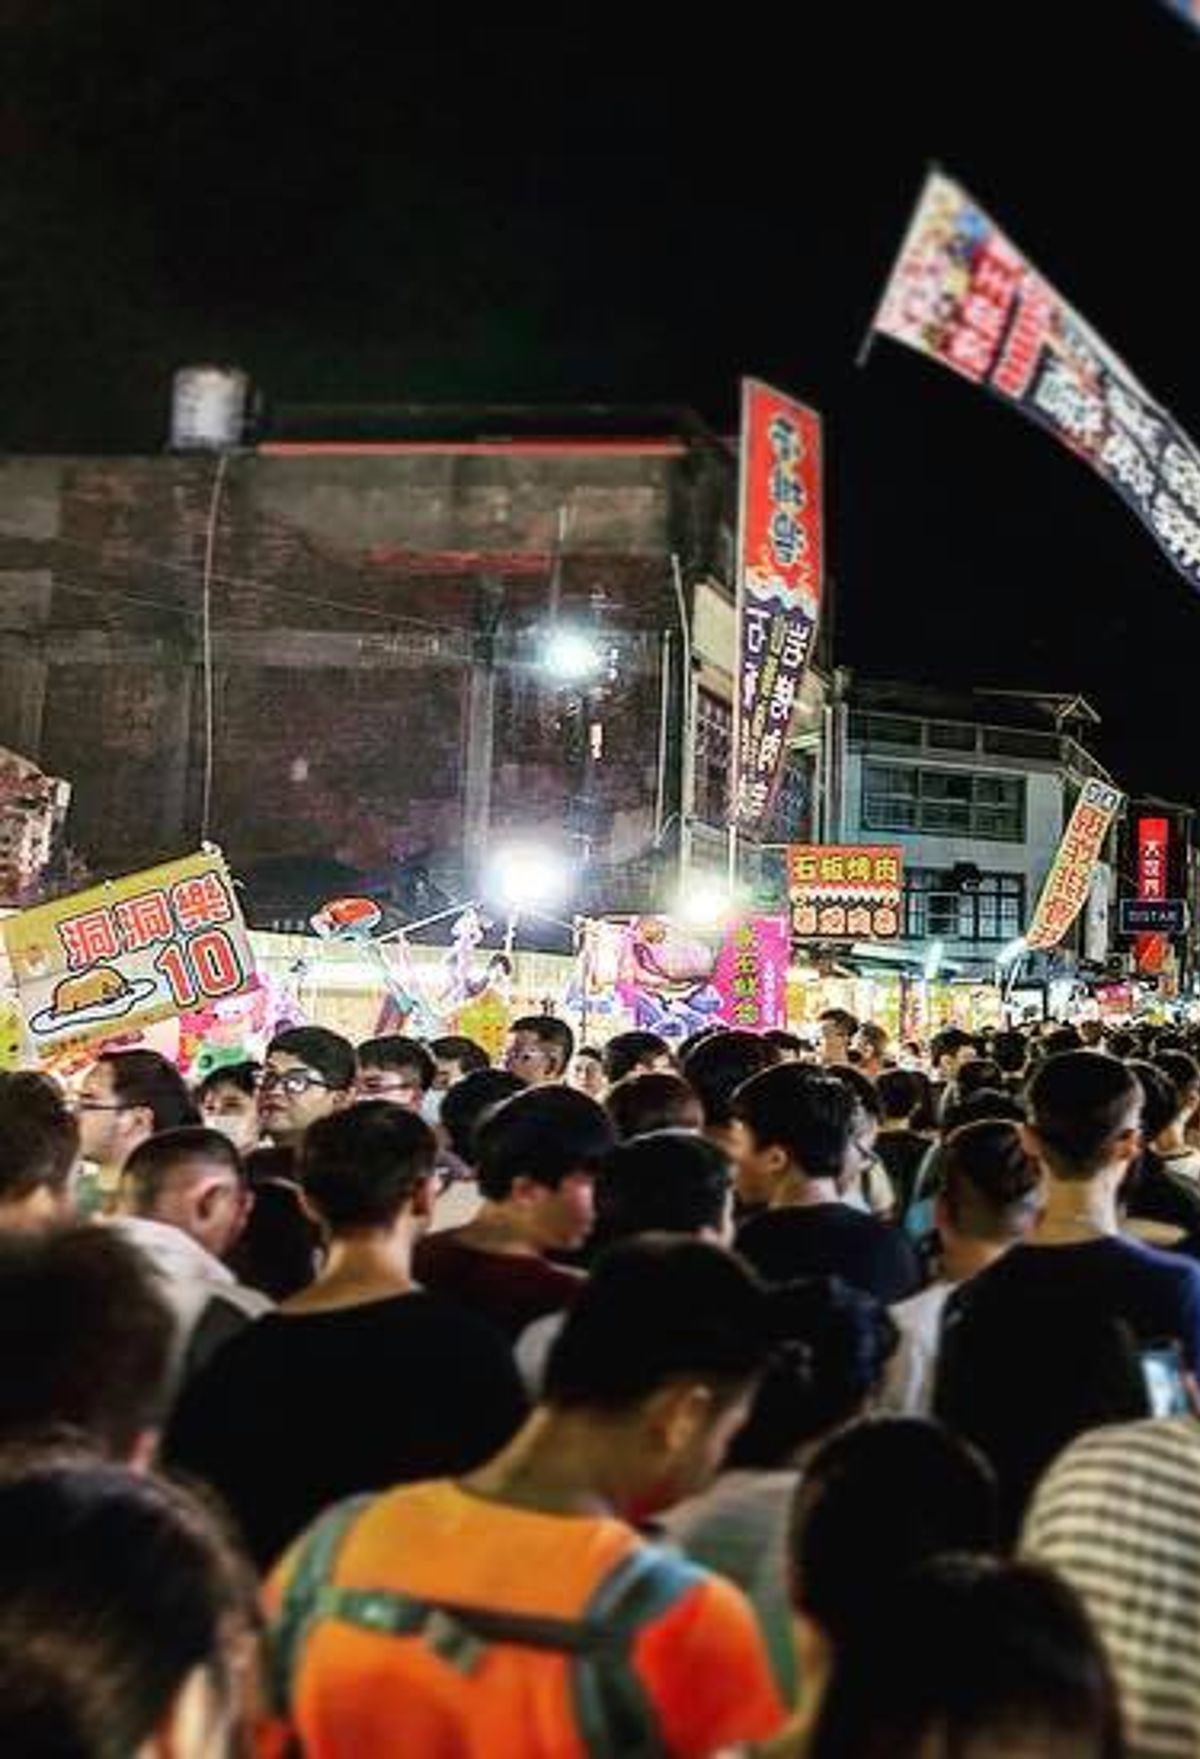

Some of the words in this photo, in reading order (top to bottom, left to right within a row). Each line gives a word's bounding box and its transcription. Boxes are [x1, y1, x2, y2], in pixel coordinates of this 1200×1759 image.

[62, 871, 232, 972] 洞洞樂
[156, 928, 243, 1006] 10
